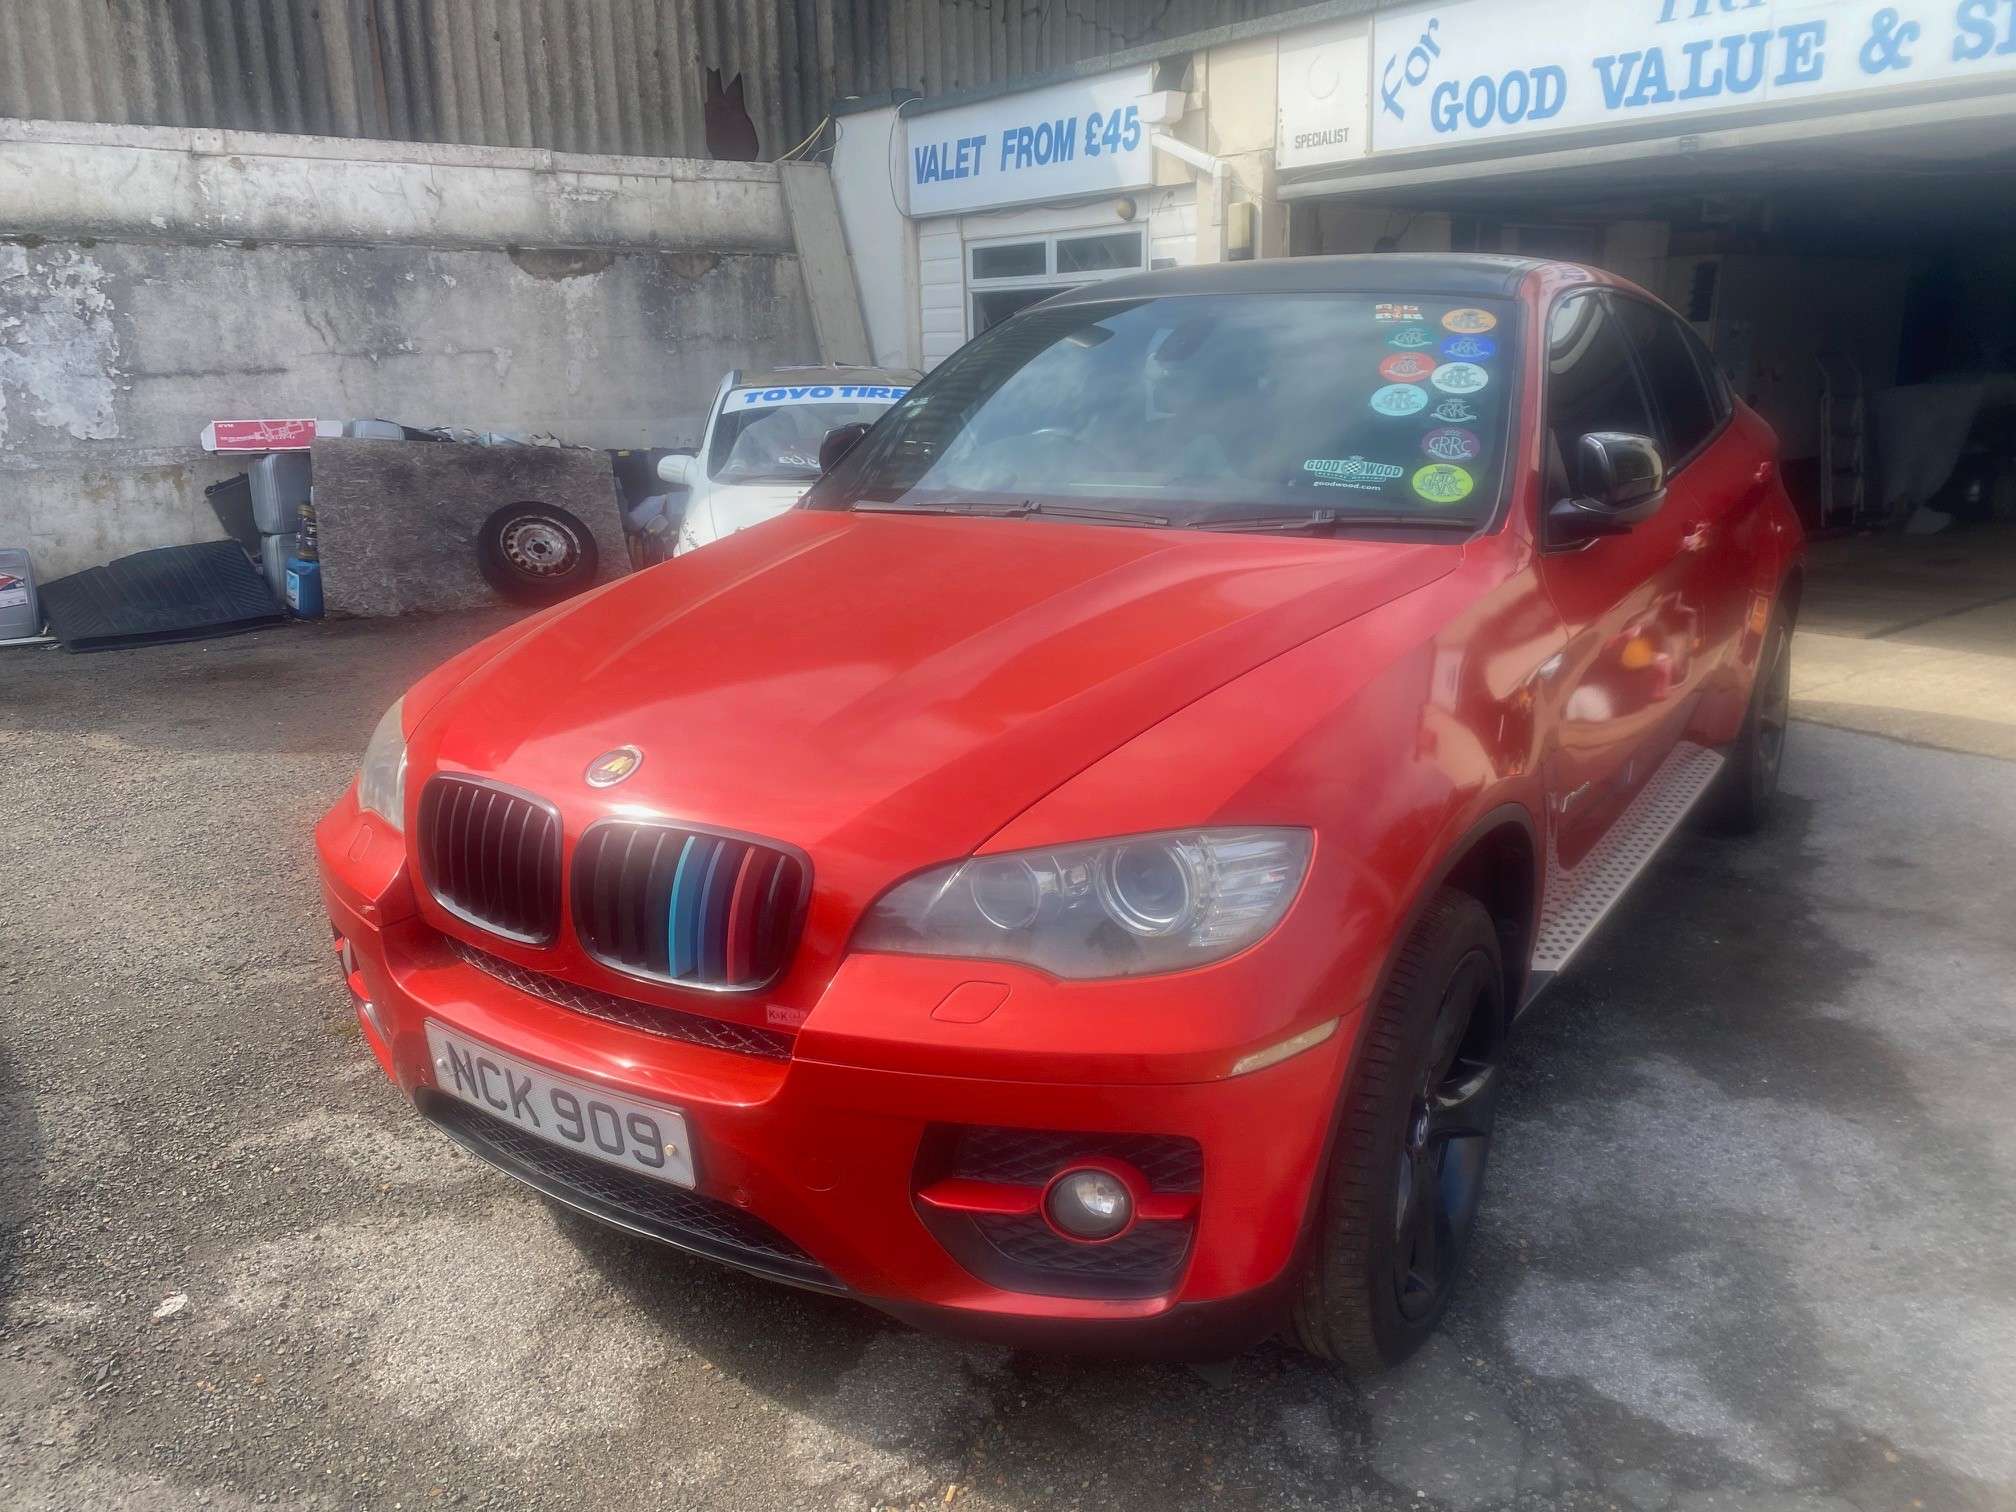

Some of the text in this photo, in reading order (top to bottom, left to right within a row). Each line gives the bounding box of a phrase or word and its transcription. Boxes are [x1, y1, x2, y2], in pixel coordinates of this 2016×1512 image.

[1430, 0, 2016, 133] GOOD VALUE & S
[915, 105, 1142, 184] VALET FROM £45
[1295, 128, 1349, 149] SPECIALIST
[744, 386, 834, 404] TOYO
[1307, 460, 1340, 472] GOOD
[1365, 463, 1400, 477] WOOD
[1313, 481, 1381, 491] goodwood.com
[446, 1040, 665, 1169] NCK 909
